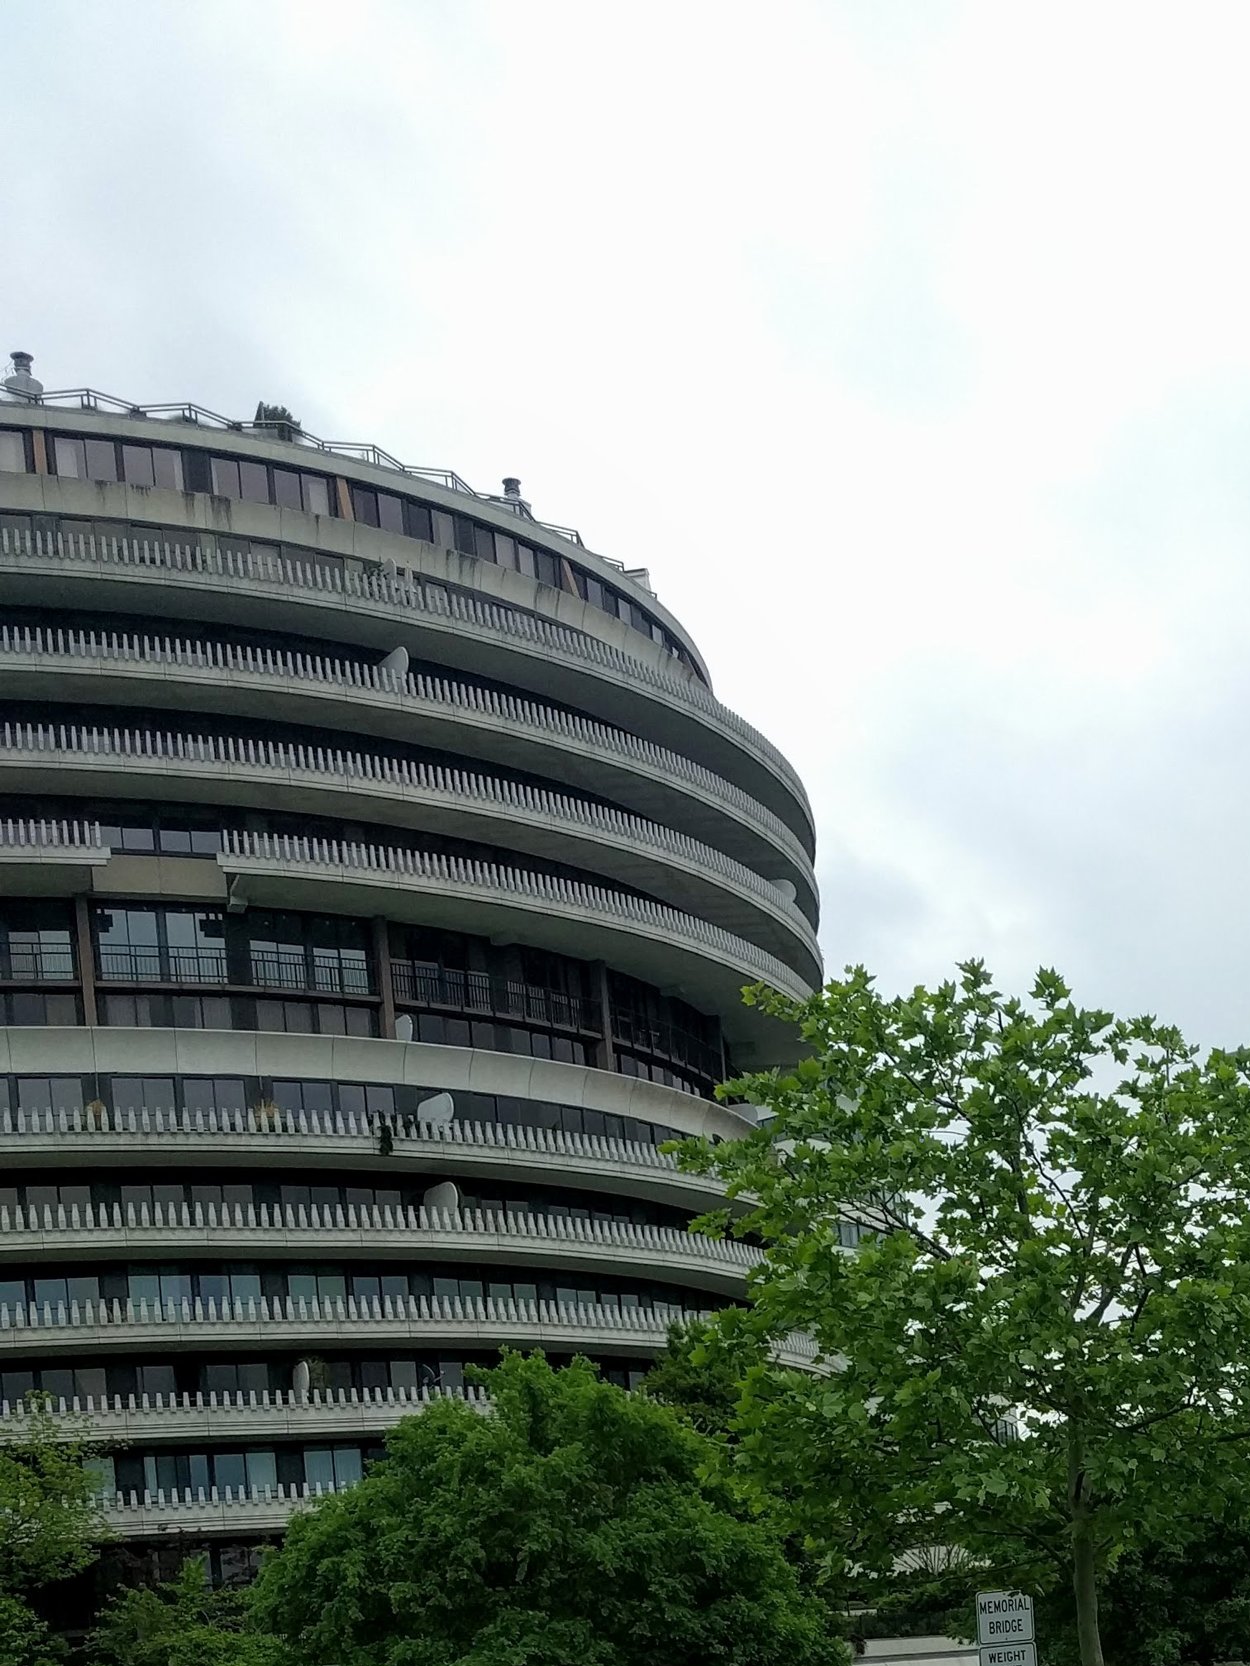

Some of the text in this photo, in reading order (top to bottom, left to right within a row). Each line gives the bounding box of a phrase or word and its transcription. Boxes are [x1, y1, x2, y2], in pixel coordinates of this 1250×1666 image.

[979, 1598, 1030, 1615] MEMORIAL
[988, 1619, 1023, 1635] BRIDGE
[988, 1650, 1026, 1664] WEIGHT
